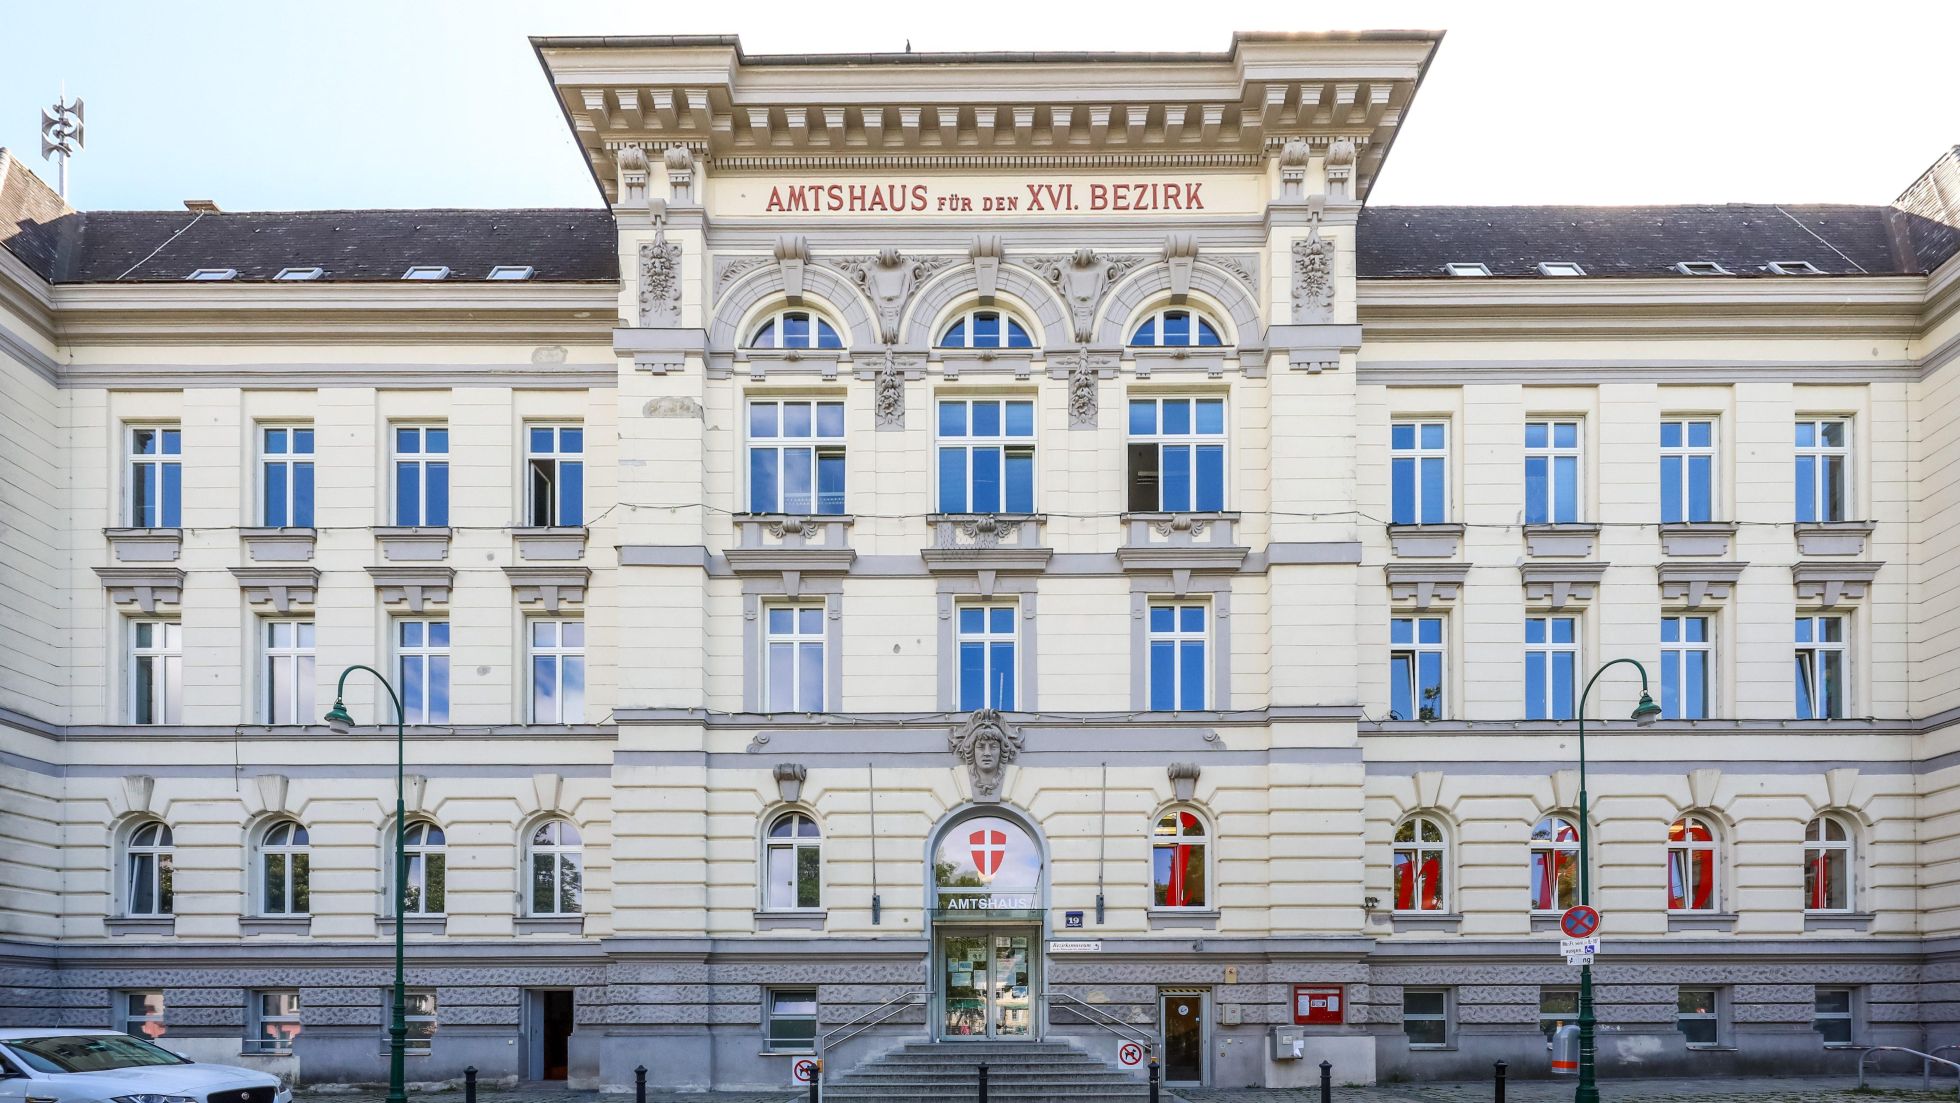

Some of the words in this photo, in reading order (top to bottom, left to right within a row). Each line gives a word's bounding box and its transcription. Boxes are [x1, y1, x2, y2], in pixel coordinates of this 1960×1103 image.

[765, 184, 928, 212] AMTSHAUS
[937, 193, 973, 212] FÜR
[982, 196, 1019, 211] DEN
[1026, 183, 1079, 211] XVI.
[1089, 182, 1205, 211] BEZIRK
[947, 898, 1027, 910] AMTSHAUS
[1068, 916, 1080, 924] 19
